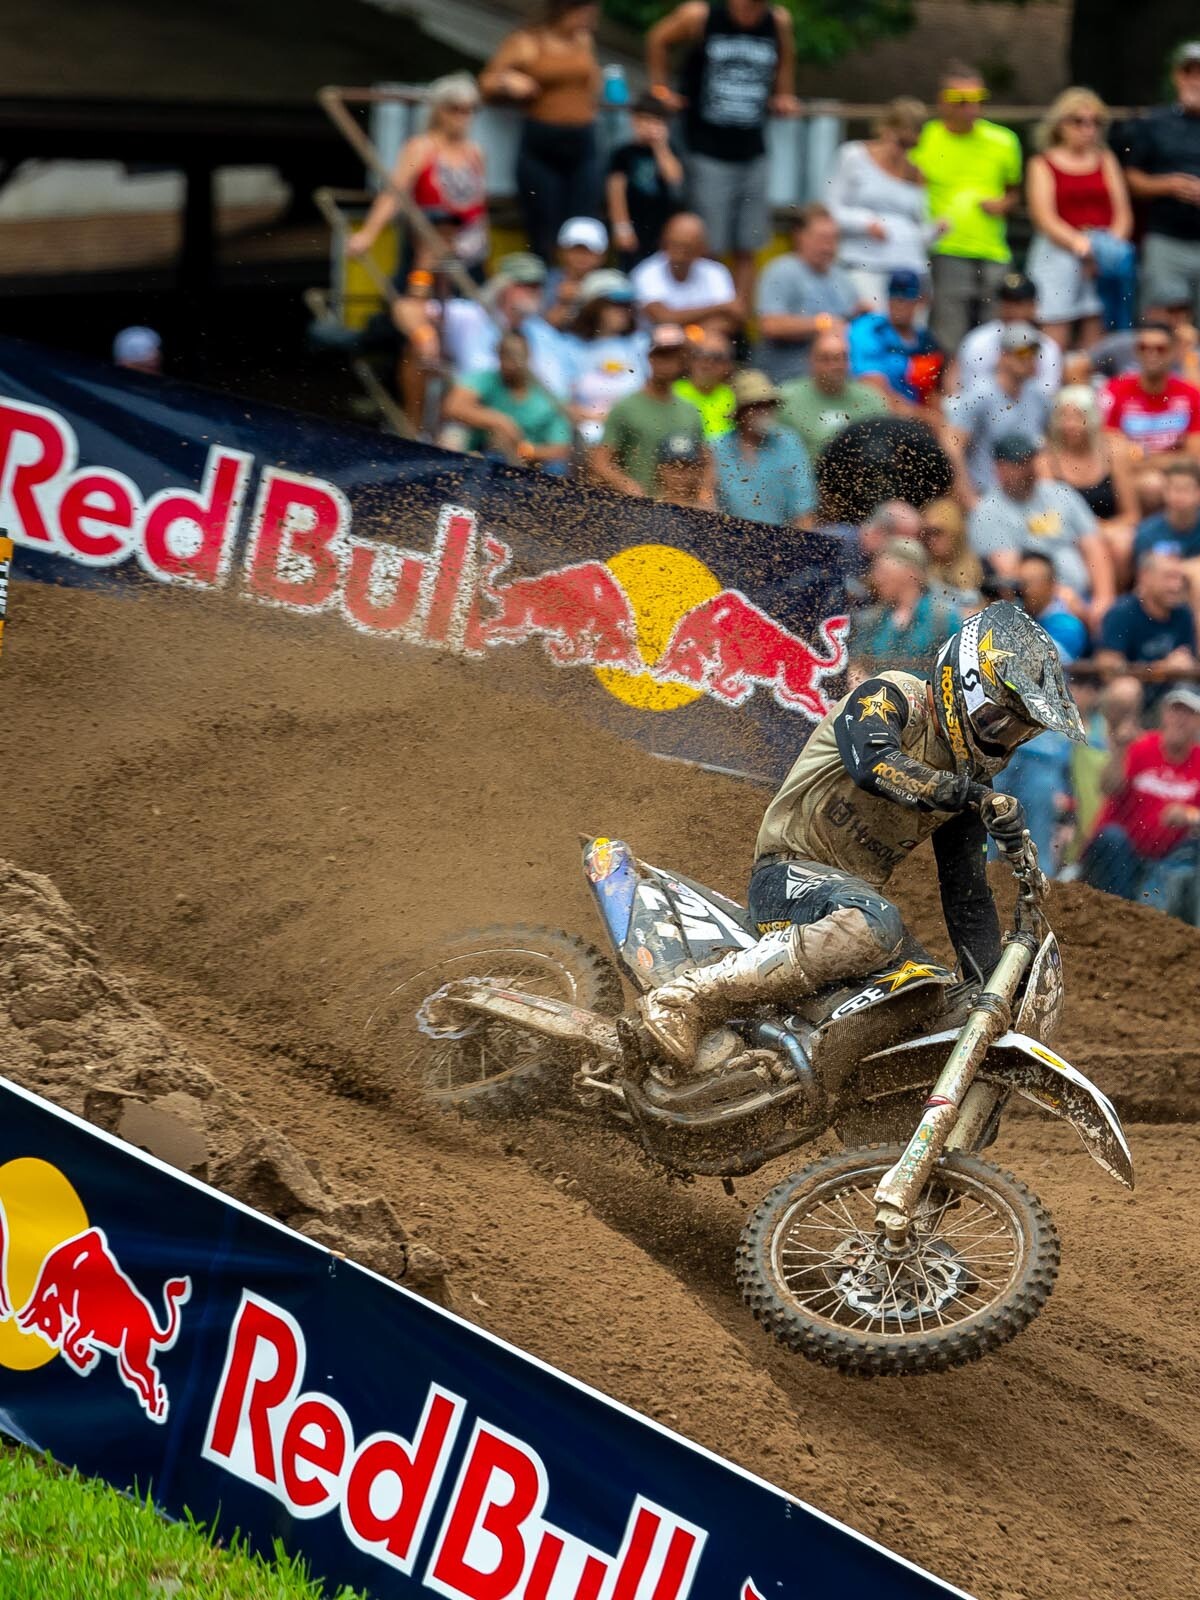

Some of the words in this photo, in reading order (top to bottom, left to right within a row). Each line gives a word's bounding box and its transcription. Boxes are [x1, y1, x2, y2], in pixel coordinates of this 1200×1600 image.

[0, 402, 243, 586] Red
[939, 665, 970, 761] ROCKSTAR
[873, 777, 907, 798] ENERGY
[210, 1300, 456, 1560] Red
